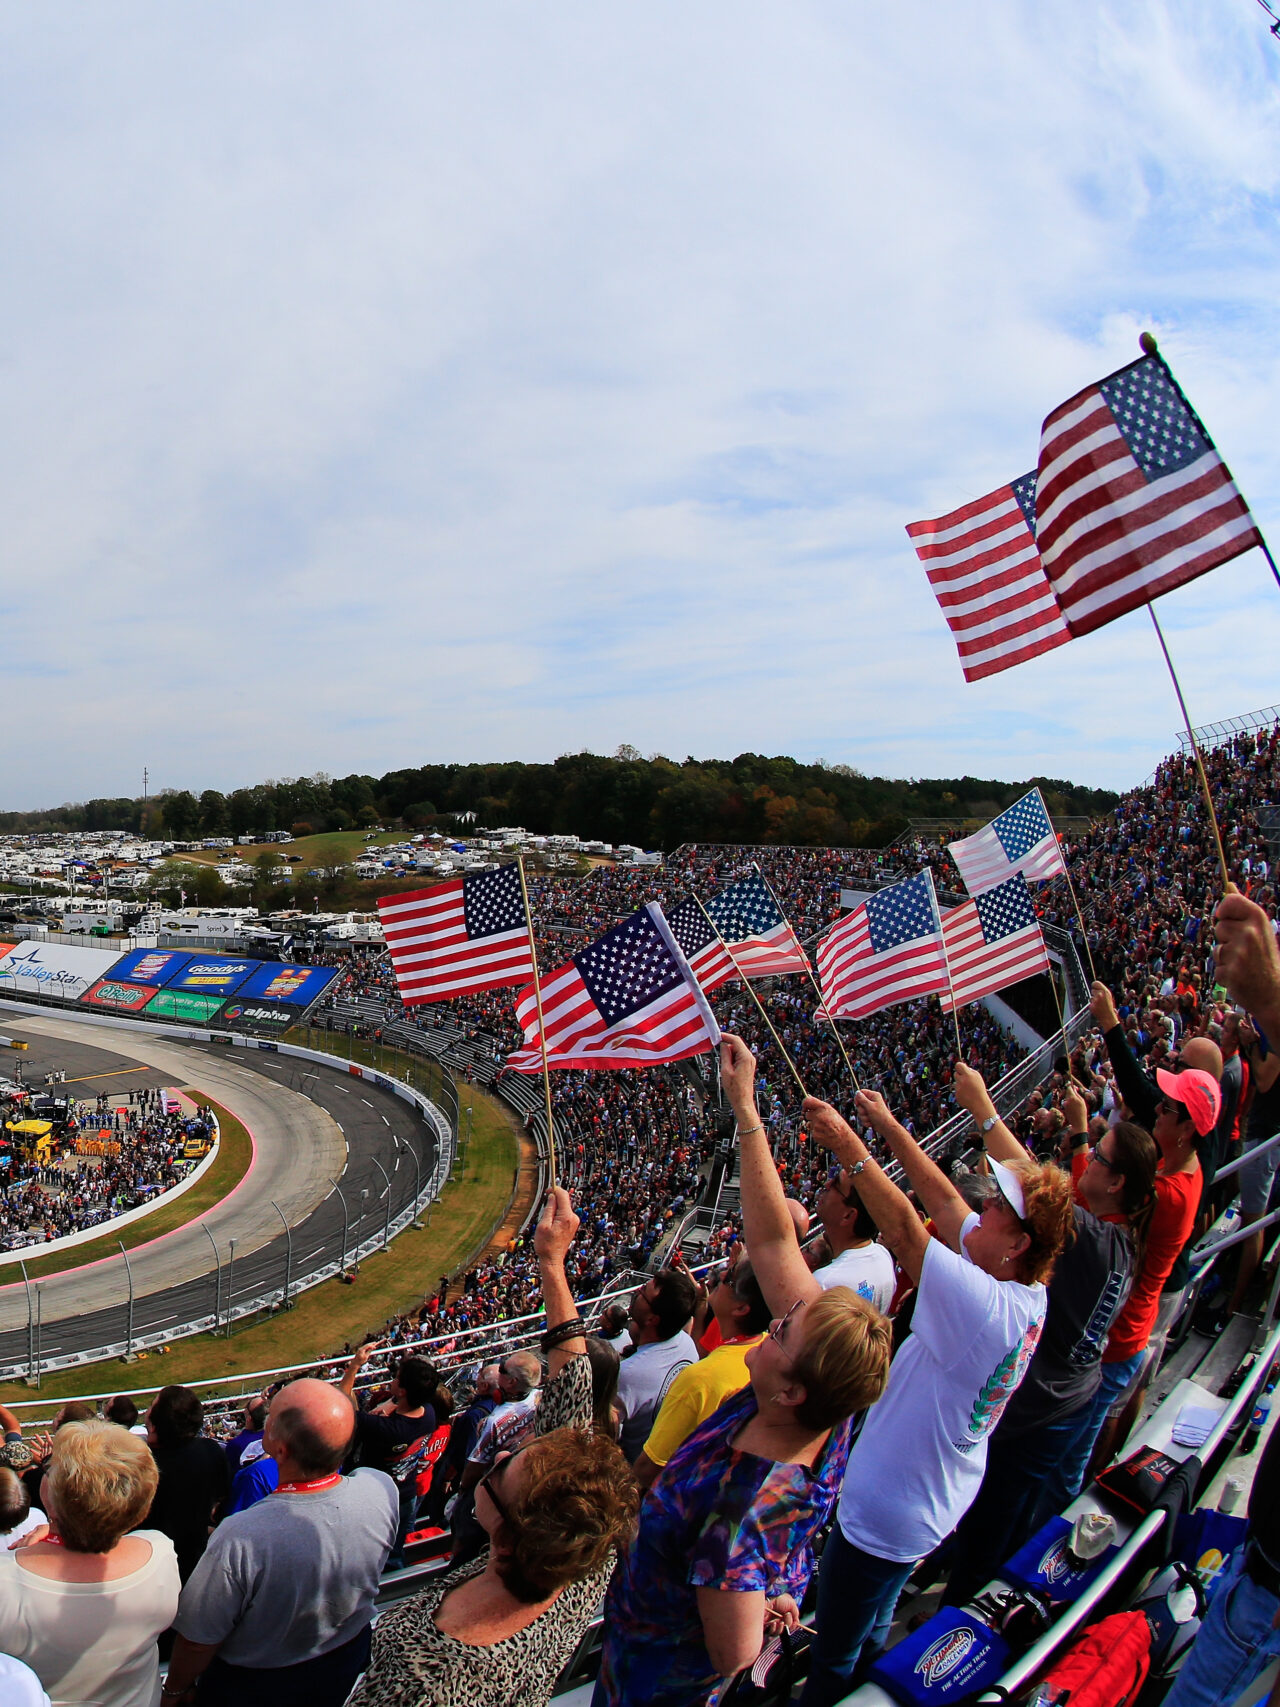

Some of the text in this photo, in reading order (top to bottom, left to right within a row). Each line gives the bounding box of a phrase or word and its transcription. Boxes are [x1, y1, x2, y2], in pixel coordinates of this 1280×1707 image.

[206, 924, 222, 933] Sprint
[188, 964, 247, 975] Goody's
[243, 1008, 291, 1022] alpha
[922, 1632, 965, 1672] RICHMOND
[941, 1679, 953, 1692] THE
[953, 1661, 973, 1682] ACTION
[972, 1644, 991, 1664] TRACK
